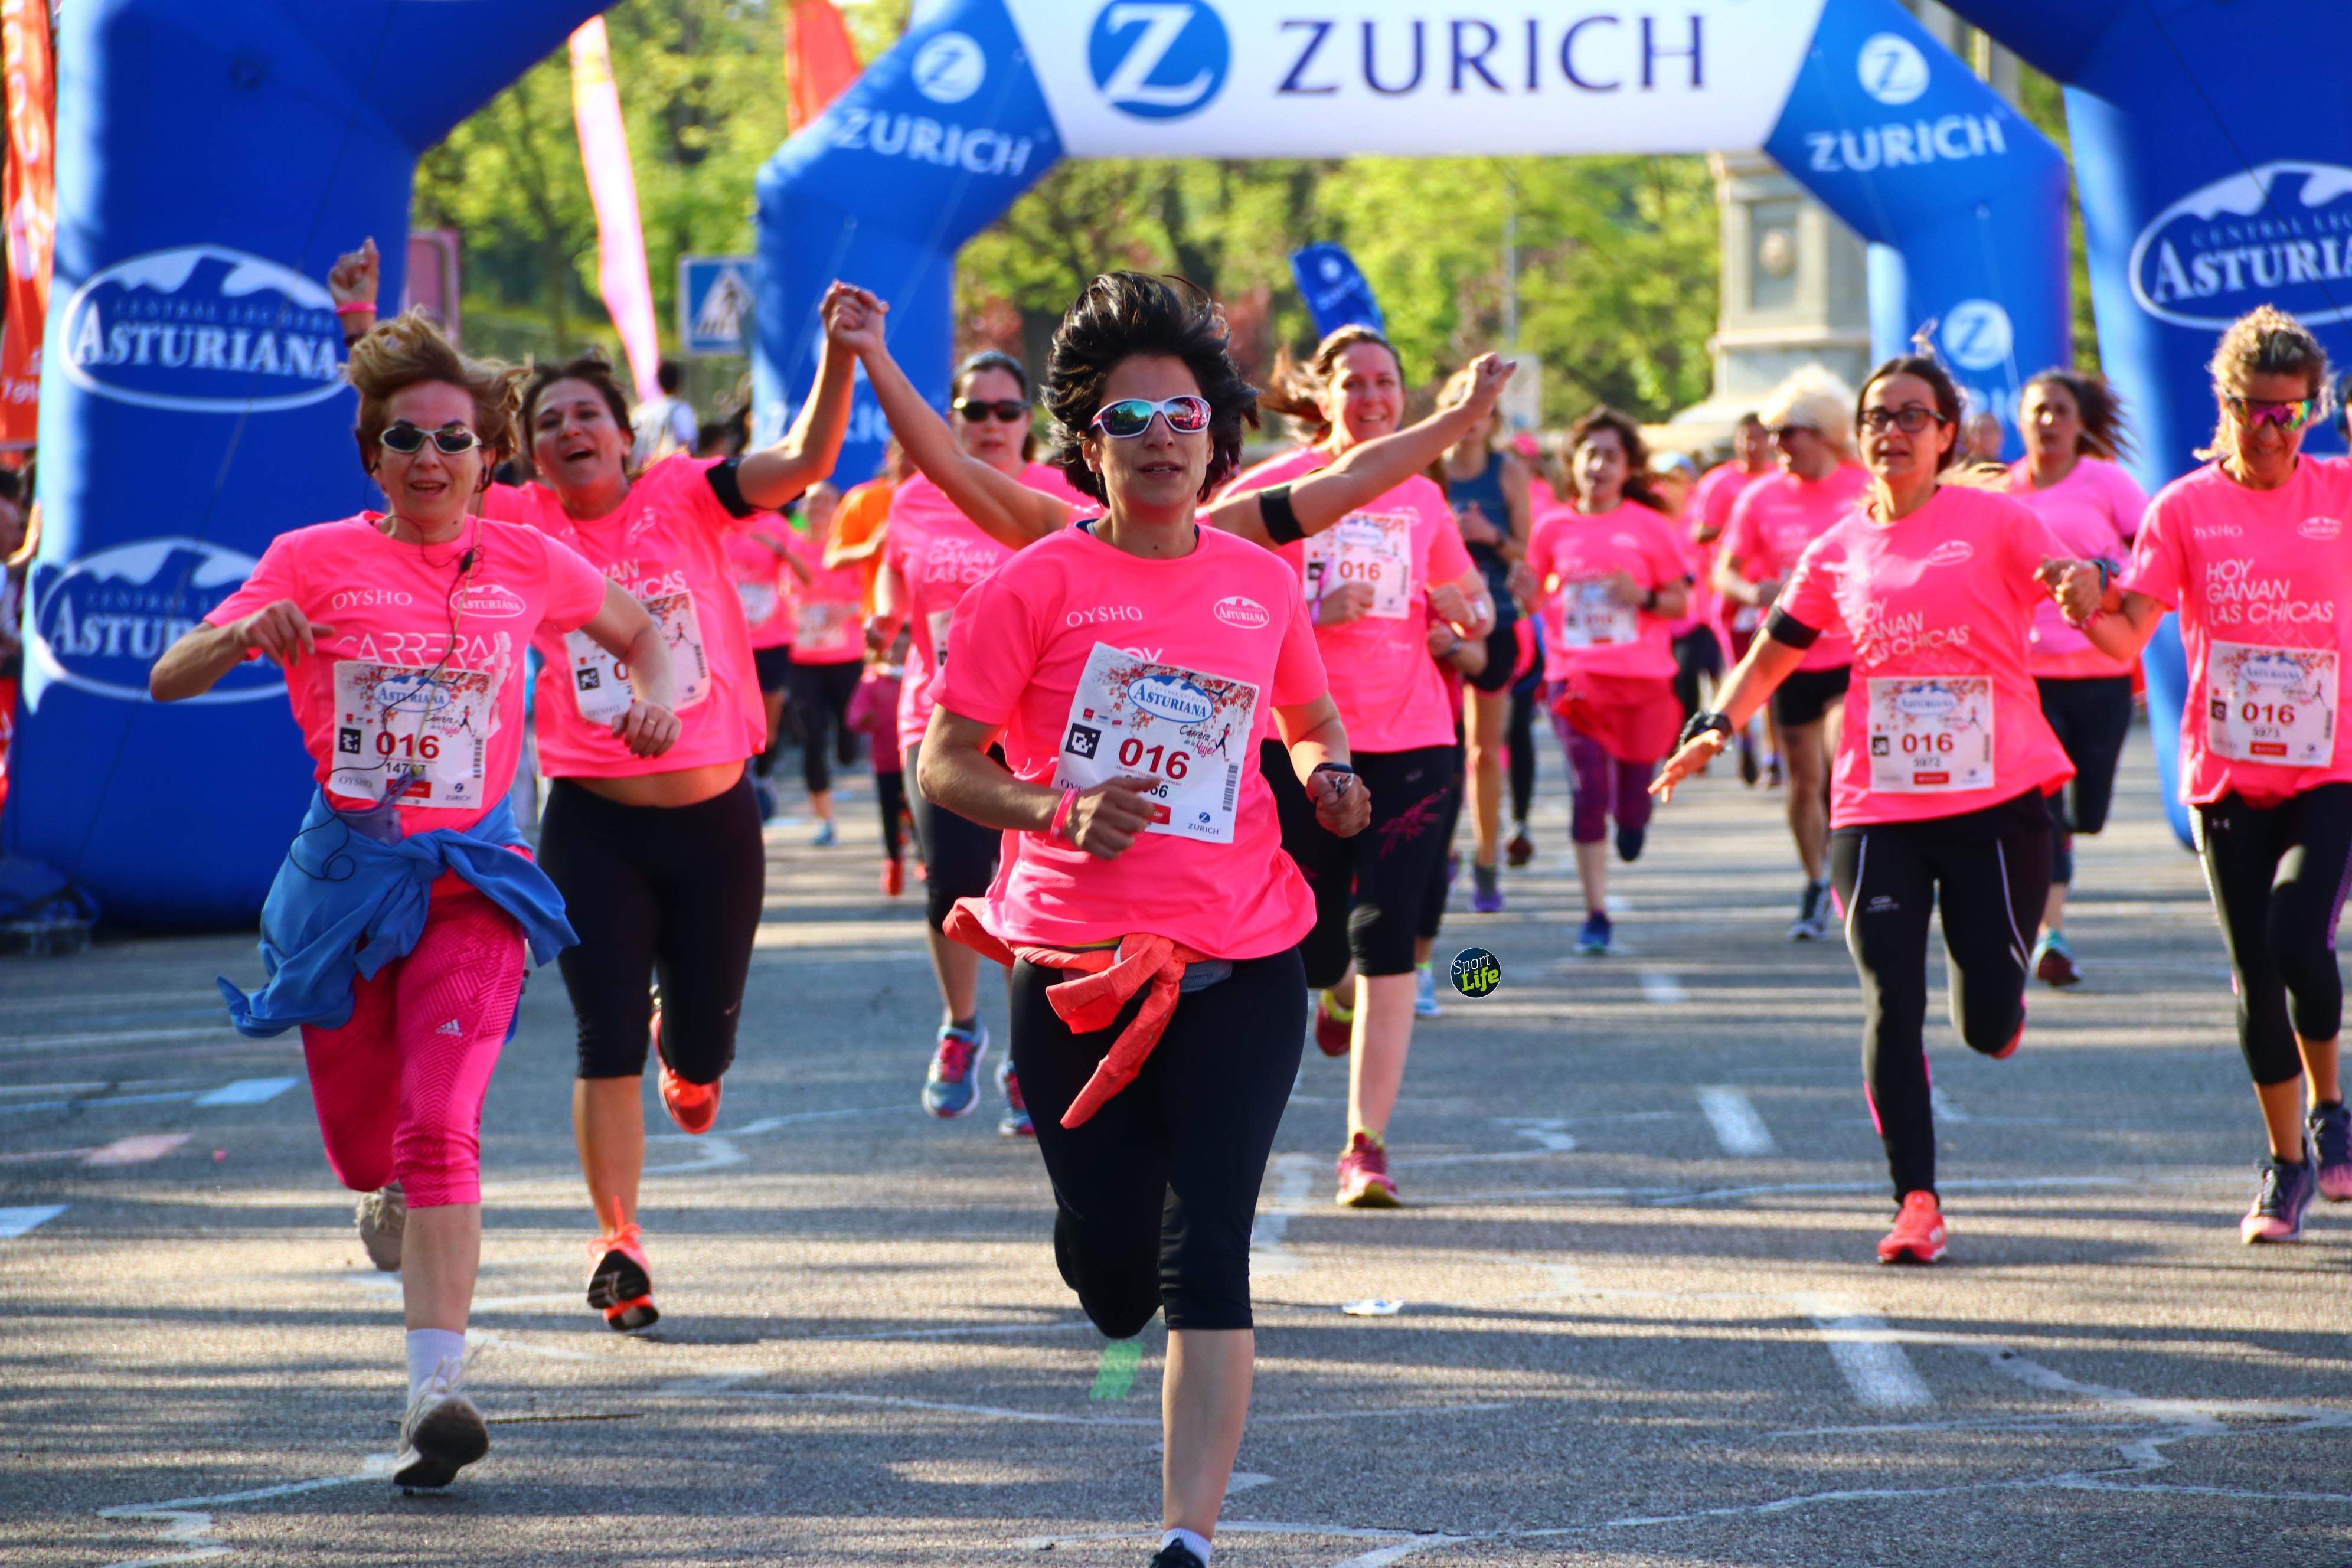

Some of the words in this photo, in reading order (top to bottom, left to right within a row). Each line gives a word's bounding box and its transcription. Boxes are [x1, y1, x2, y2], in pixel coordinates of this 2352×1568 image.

[1275, 15, 1705, 95] ZURICH
[828, 107, 1033, 176] ZURICH
[1804, 113, 2007, 172] ZURICH
[72, 299, 339, 381] ASTURIANA
[1339, 561, 1381, 581] 016
[2206, 558, 2254, 582] HOY
[332, 590, 413, 610] OYSHO
[2206, 579, 2291, 605] GANAN
[1066, 606, 1142, 627] OYSHO
[1219, 605, 1265, 623] ASTURIANA
[2210, 603, 2242, 626] LAS
[2248, 600, 2334, 623] CHICAS
[1133, 683, 1206, 717] ASTURIANA
[2242, 702, 2295, 725] 016
[1180, 724, 1211, 741] Carrera
[1902, 733, 1954, 753] 016
[376, 731, 440, 760] 016
[1193, 740, 1218, 758] Mujer
[1118, 738, 1191, 779] 016
[1188, 823, 1219, 835] ZURICH
